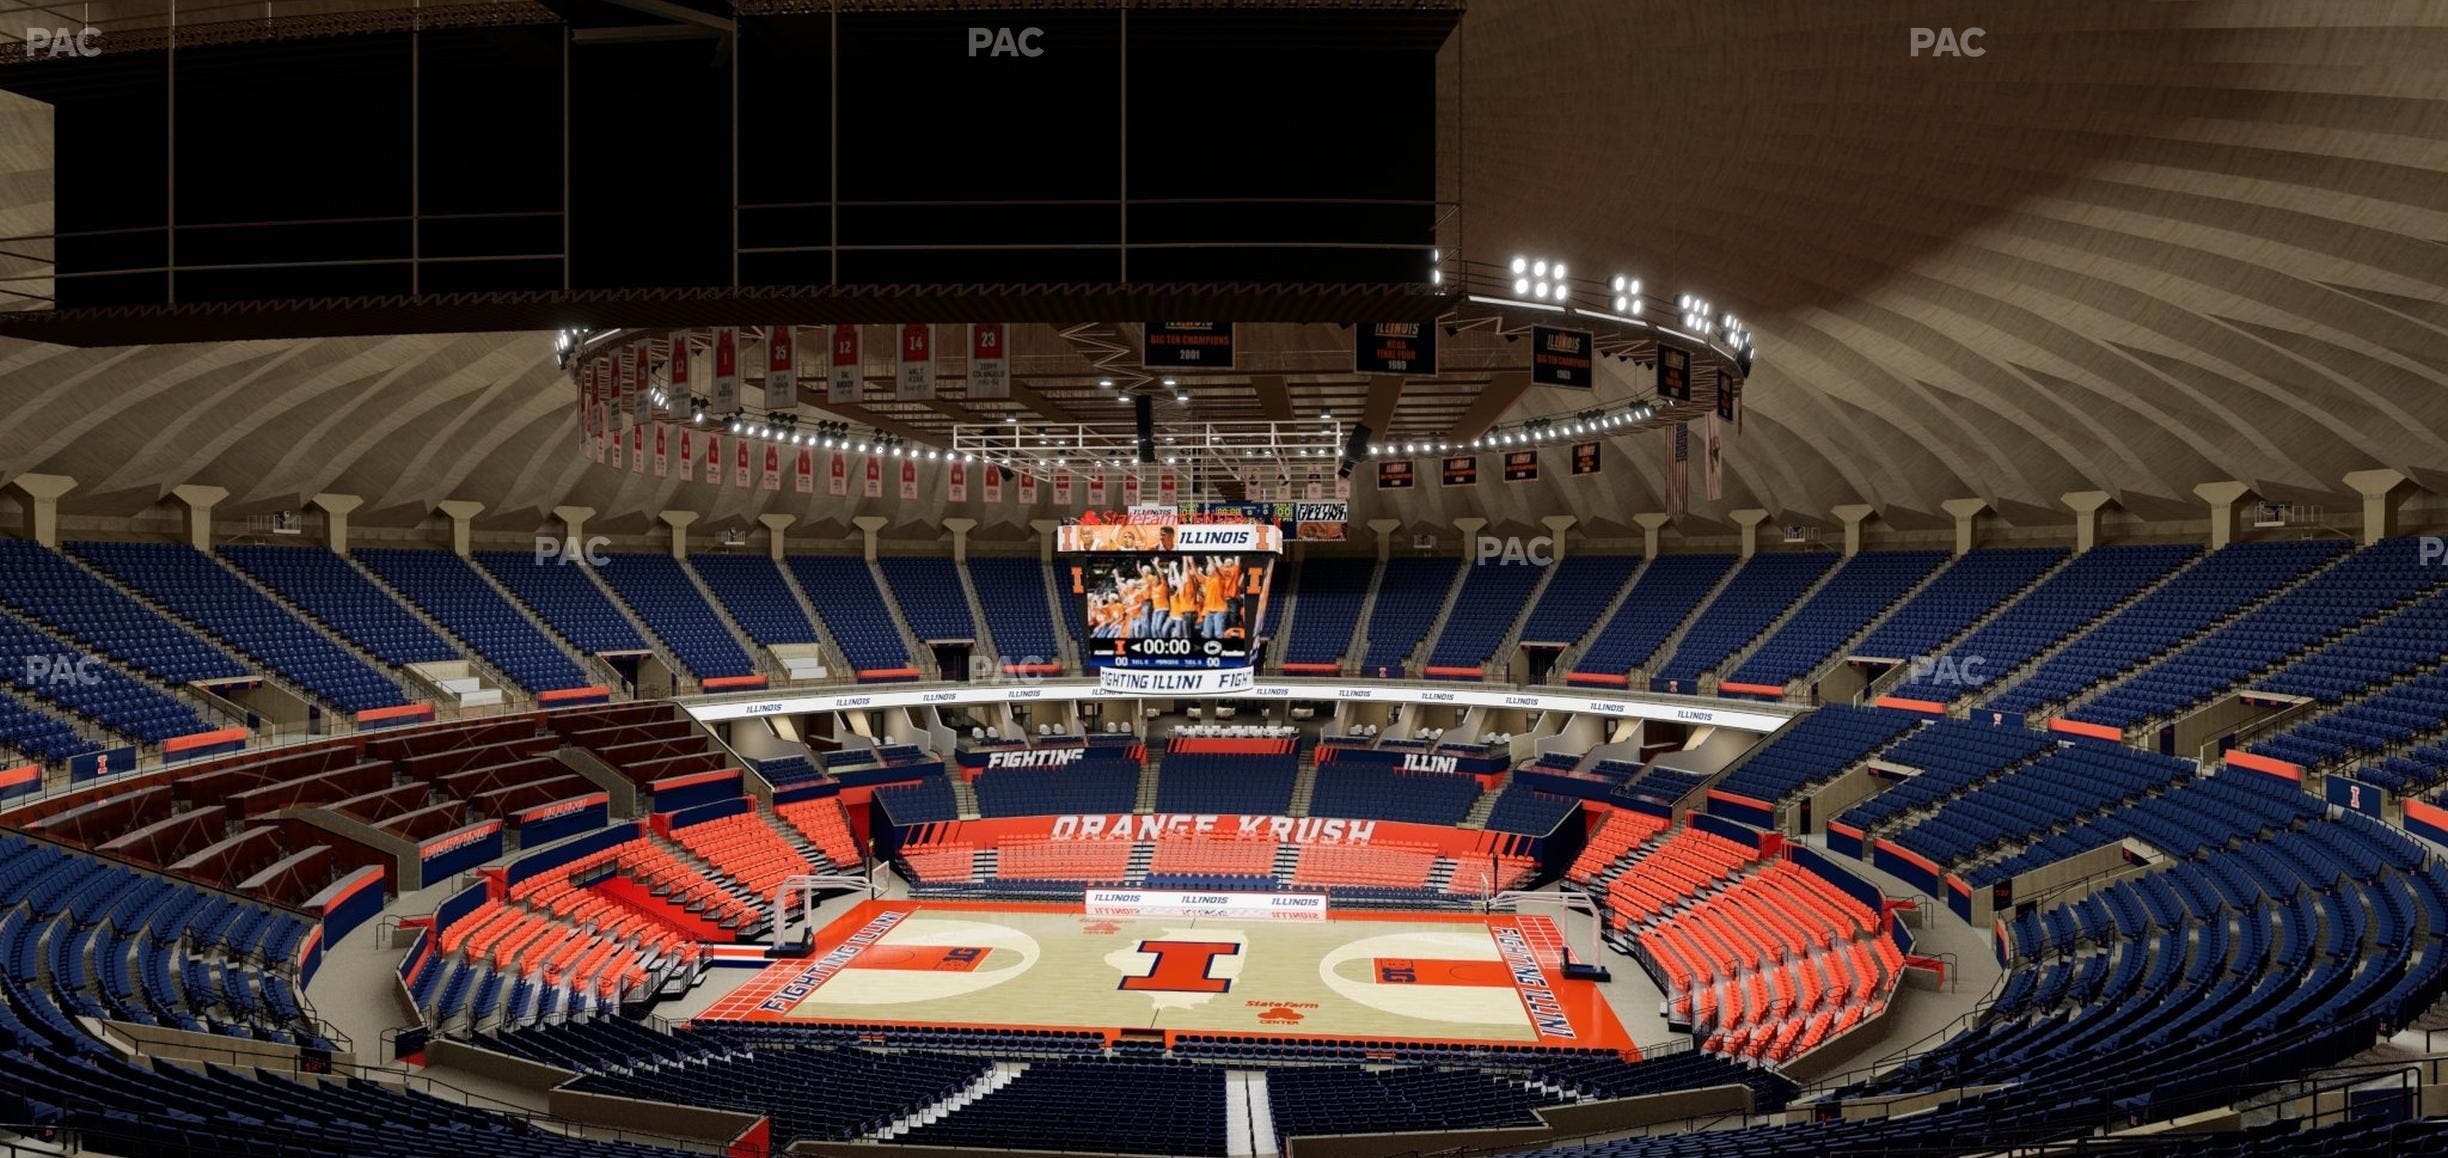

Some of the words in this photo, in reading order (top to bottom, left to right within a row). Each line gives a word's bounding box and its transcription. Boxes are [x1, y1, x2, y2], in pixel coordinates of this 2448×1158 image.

[909, 336, 923, 351] 14
[981, 332, 995, 347] 23
[839, 341, 851, 354] 12
[1298, 503, 1346, 512] FIGHTING
[1179, 532, 1249, 544] ILLINOIS
[1143, 639, 1190, 654] 00:00
[1115, 657, 1128, 667] 00
[1206, 657, 1220, 667] 00
[1152, 674, 1203, 690] ILLINI
[923, 692, 956, 702] ILLINOIS
[1008, 689, 1041, 698] ILLINOIS
[1256, 688, 1289, 696] ILLINOIS
[1339, 690, 1371, 698] ILLINOIS
[1421, 693, 1454, 701] ILLINOIS
[836, 697, 870, 707] ILLINOIS
[1505, 697, 1539, 705] ILLINOIS
[746, 703, 782, 714] ILLINOIS
[1590, 703, 1625, 712] ILLINOIS
[1677, 709, 1713, 721] ILLINOIS
[1403, 753, 1458, 774] ILLINI
[1050, 814, 1217, 842] ORANGE
[1236, 816, 1377, 844] KRUSH
[1094, 893, 1141, 903] ILLINOIS
[1182, 895, 1229, 905] ILLINOIS
[1271, 897, 1319, 907] ILLINOIS
[758, 944, 861, 1013] FIGHTING
[1521, 987, 1576, 1039] ILLINI
